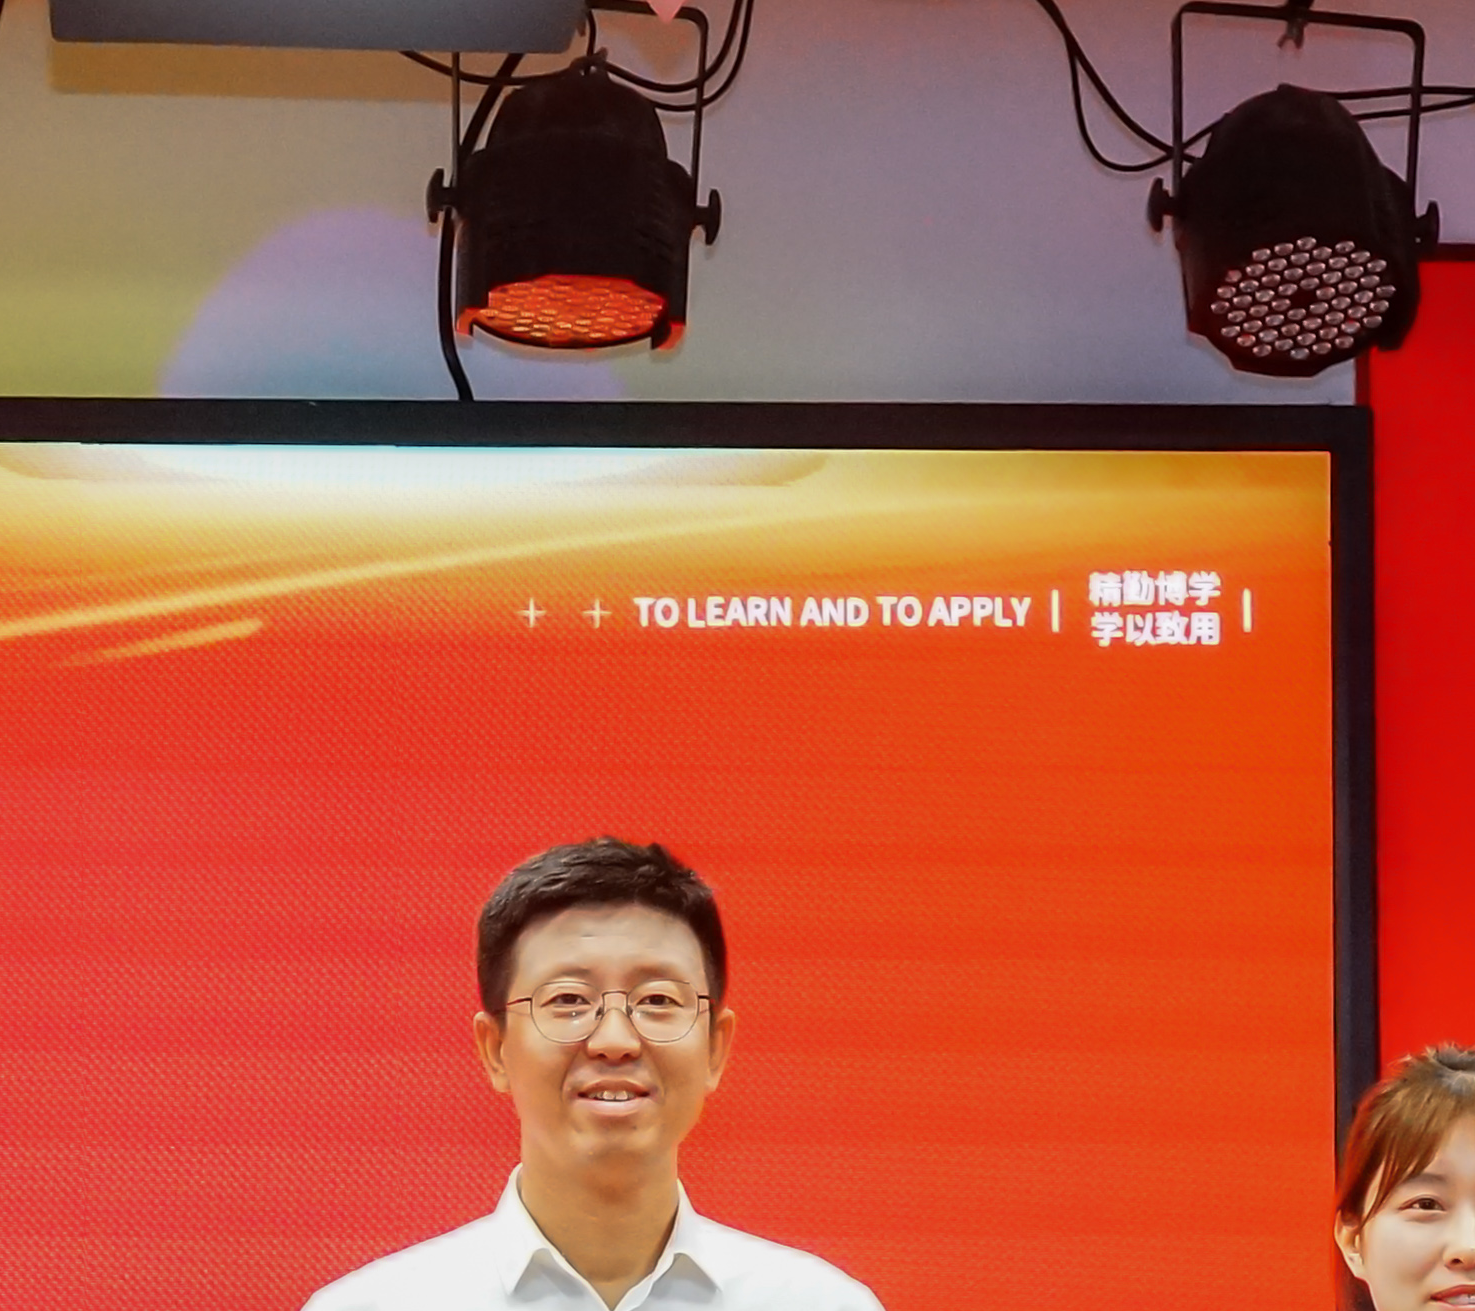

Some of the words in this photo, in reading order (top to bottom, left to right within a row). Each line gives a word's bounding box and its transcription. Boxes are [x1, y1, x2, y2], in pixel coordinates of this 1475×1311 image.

[633, 596, 680, 628] TO
[687, 596, 792, 628] LEARN
[800, 596, 870, 627] AND
[876, 596, 923, 627] TO
[927, 596, 1032, 627] APPLY
[1090, 611, 1221, 647] 学以致用
